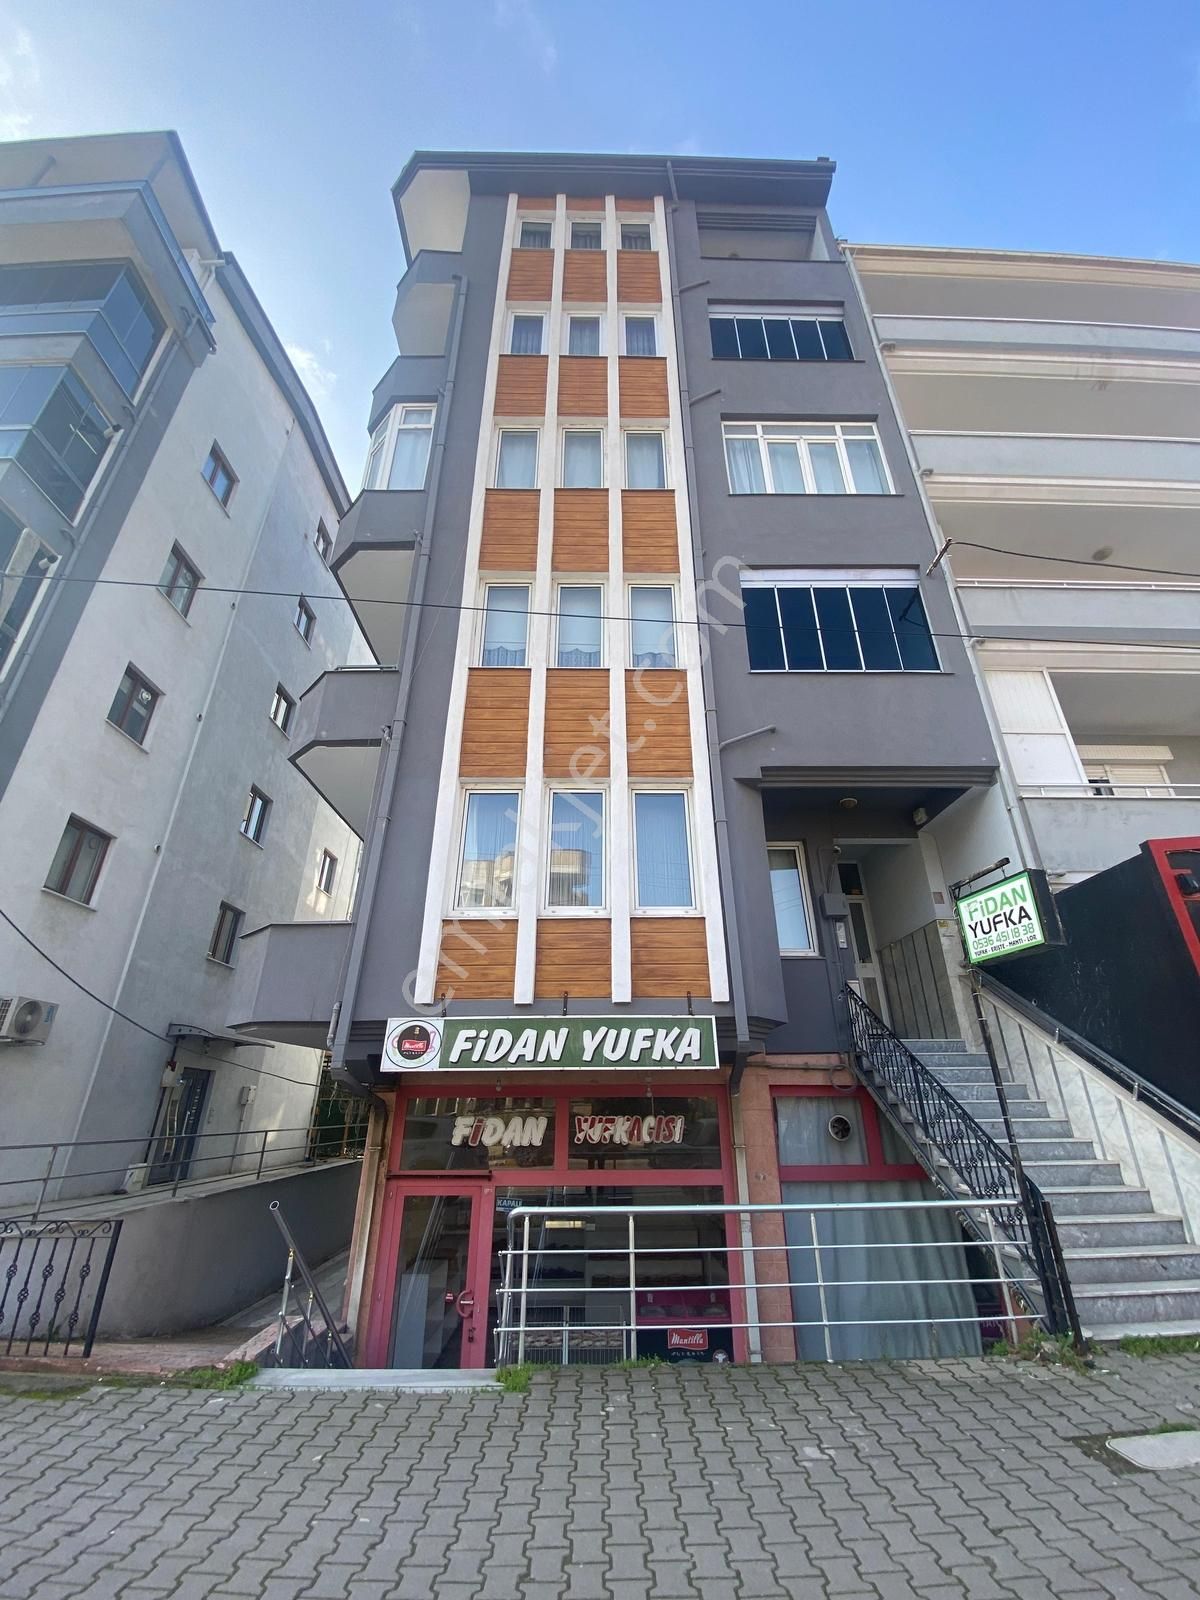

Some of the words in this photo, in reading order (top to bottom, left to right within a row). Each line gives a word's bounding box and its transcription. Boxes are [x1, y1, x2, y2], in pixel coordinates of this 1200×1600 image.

[968, 905, 1032, 938] YUFKA
[972, 935, 994, 950] 0536
[996, 930, 1010, 943] 451
[1011, 927, 1021, 939] 18
[1021, 922, 1035, 936] 38
[582, 1027, 701, 1063] YUFKA
[574, 1115, 684, 1145] YUFKACISI
